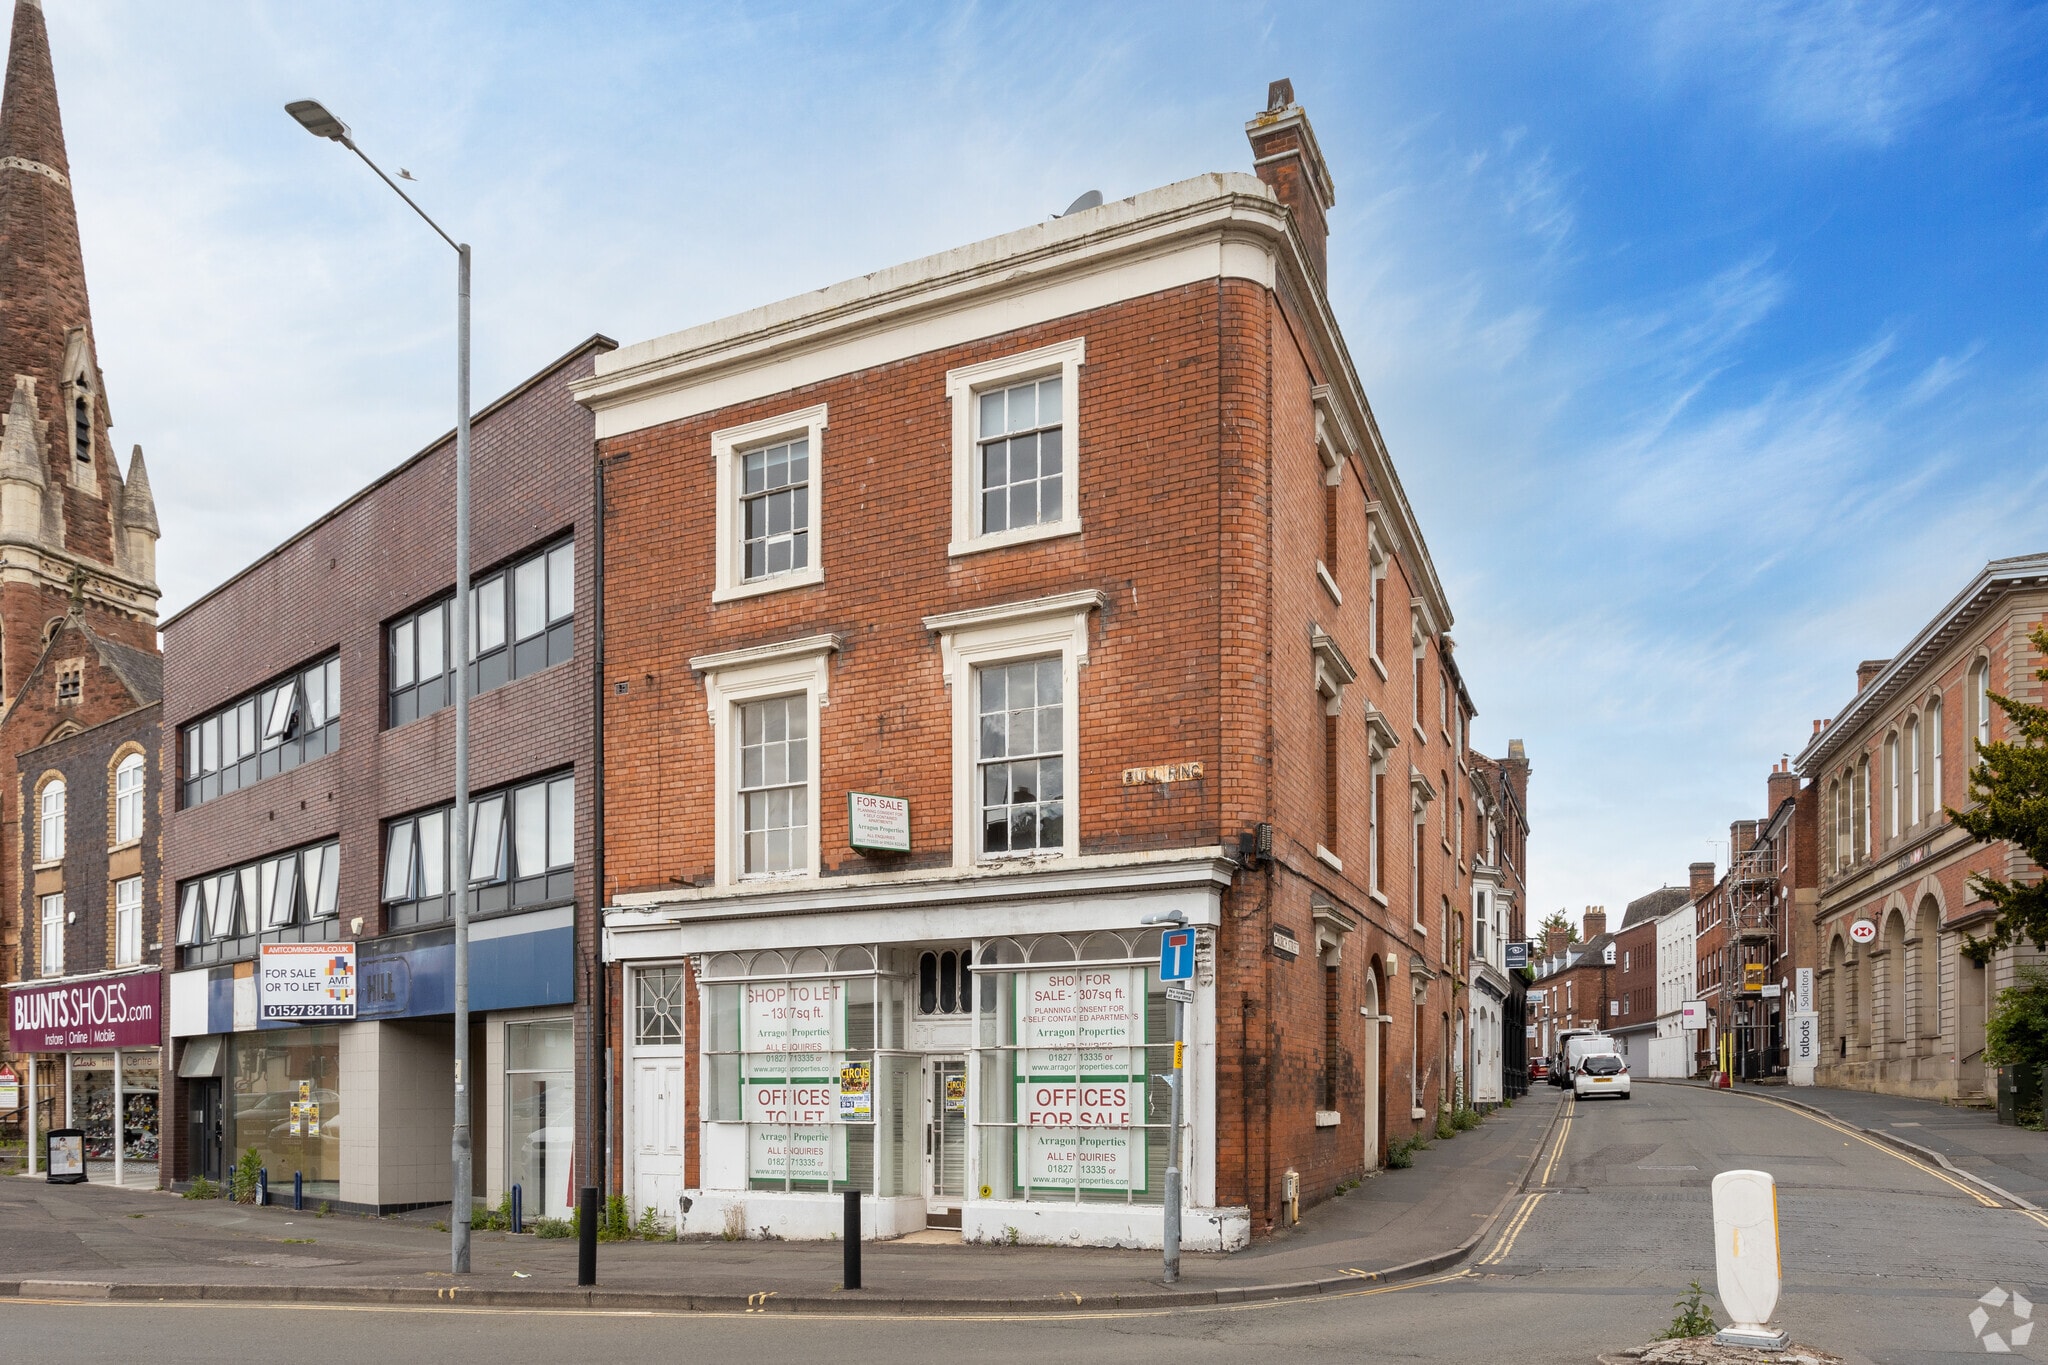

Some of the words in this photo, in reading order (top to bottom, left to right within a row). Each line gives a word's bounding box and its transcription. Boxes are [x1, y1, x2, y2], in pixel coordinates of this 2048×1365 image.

[857, 796, 876, 807] FOR
[880, 800, 902, 810] SALE
[266, 970, 287, 978] FOR
[290, 969, 316, 978] SALE
[1086, 974, 1110, 985] FOR
[266, 983, 281, 992] OR
[284, 983, 299, 992] TO
[303, 982, 321, 991] LET
[749, 988, 785, 1003] SHOP
[790, 987, 809, 1001] TO
[814, 986, 840, 1000] LET
[1035, 990, 1065, 1001] SALE
[1115, 988, 1125, 998] ft.
[268, 1006, 304, 1016] 01527
[307, 1006, 327, 1015] 821
[332, 1006, 350, 1015] 111
[813, 1006, 824, 1018] ft.
[45, 1033, 63, 1045] Instore
[69, 1031, 88, 1044] Online
[94, 1029, 115, 1042] Mobile
[758, 1030, 788, 1038] Arrago
[792, 1028, 830, 1038] Properties
[1037, 1029, 1075, 1038] Arragon
[1079, 1026, 1125, 1038] Properties
[1800, 1020, 1809, 1057] talbots
[73, 1057, 96, 1067] Clarks
[126, 1056, 152, 1066] Centre
[841, 1068, 870, 1079] CIRCUS
[947, 1081, 966, 1089] CIRCU
[758, 1089, 829, 1105] OFFICES
[1036, 1089, 1126, 1106] OFFICES
[795, 1110, 824, 1126] LET
[1030, 1112, 1072, 1129] FOR
[1080, 1112, 1129, 1130] SALE
[760, 1133, 787, 1142] Arrago
[794, 1133, 829, 1142] Propertie
[1038, 1137, 1076, 1147] Arragon
[1080, 1137, 1126, 1148] Properties
[1080, 1166, 1106, 1174] 13335
